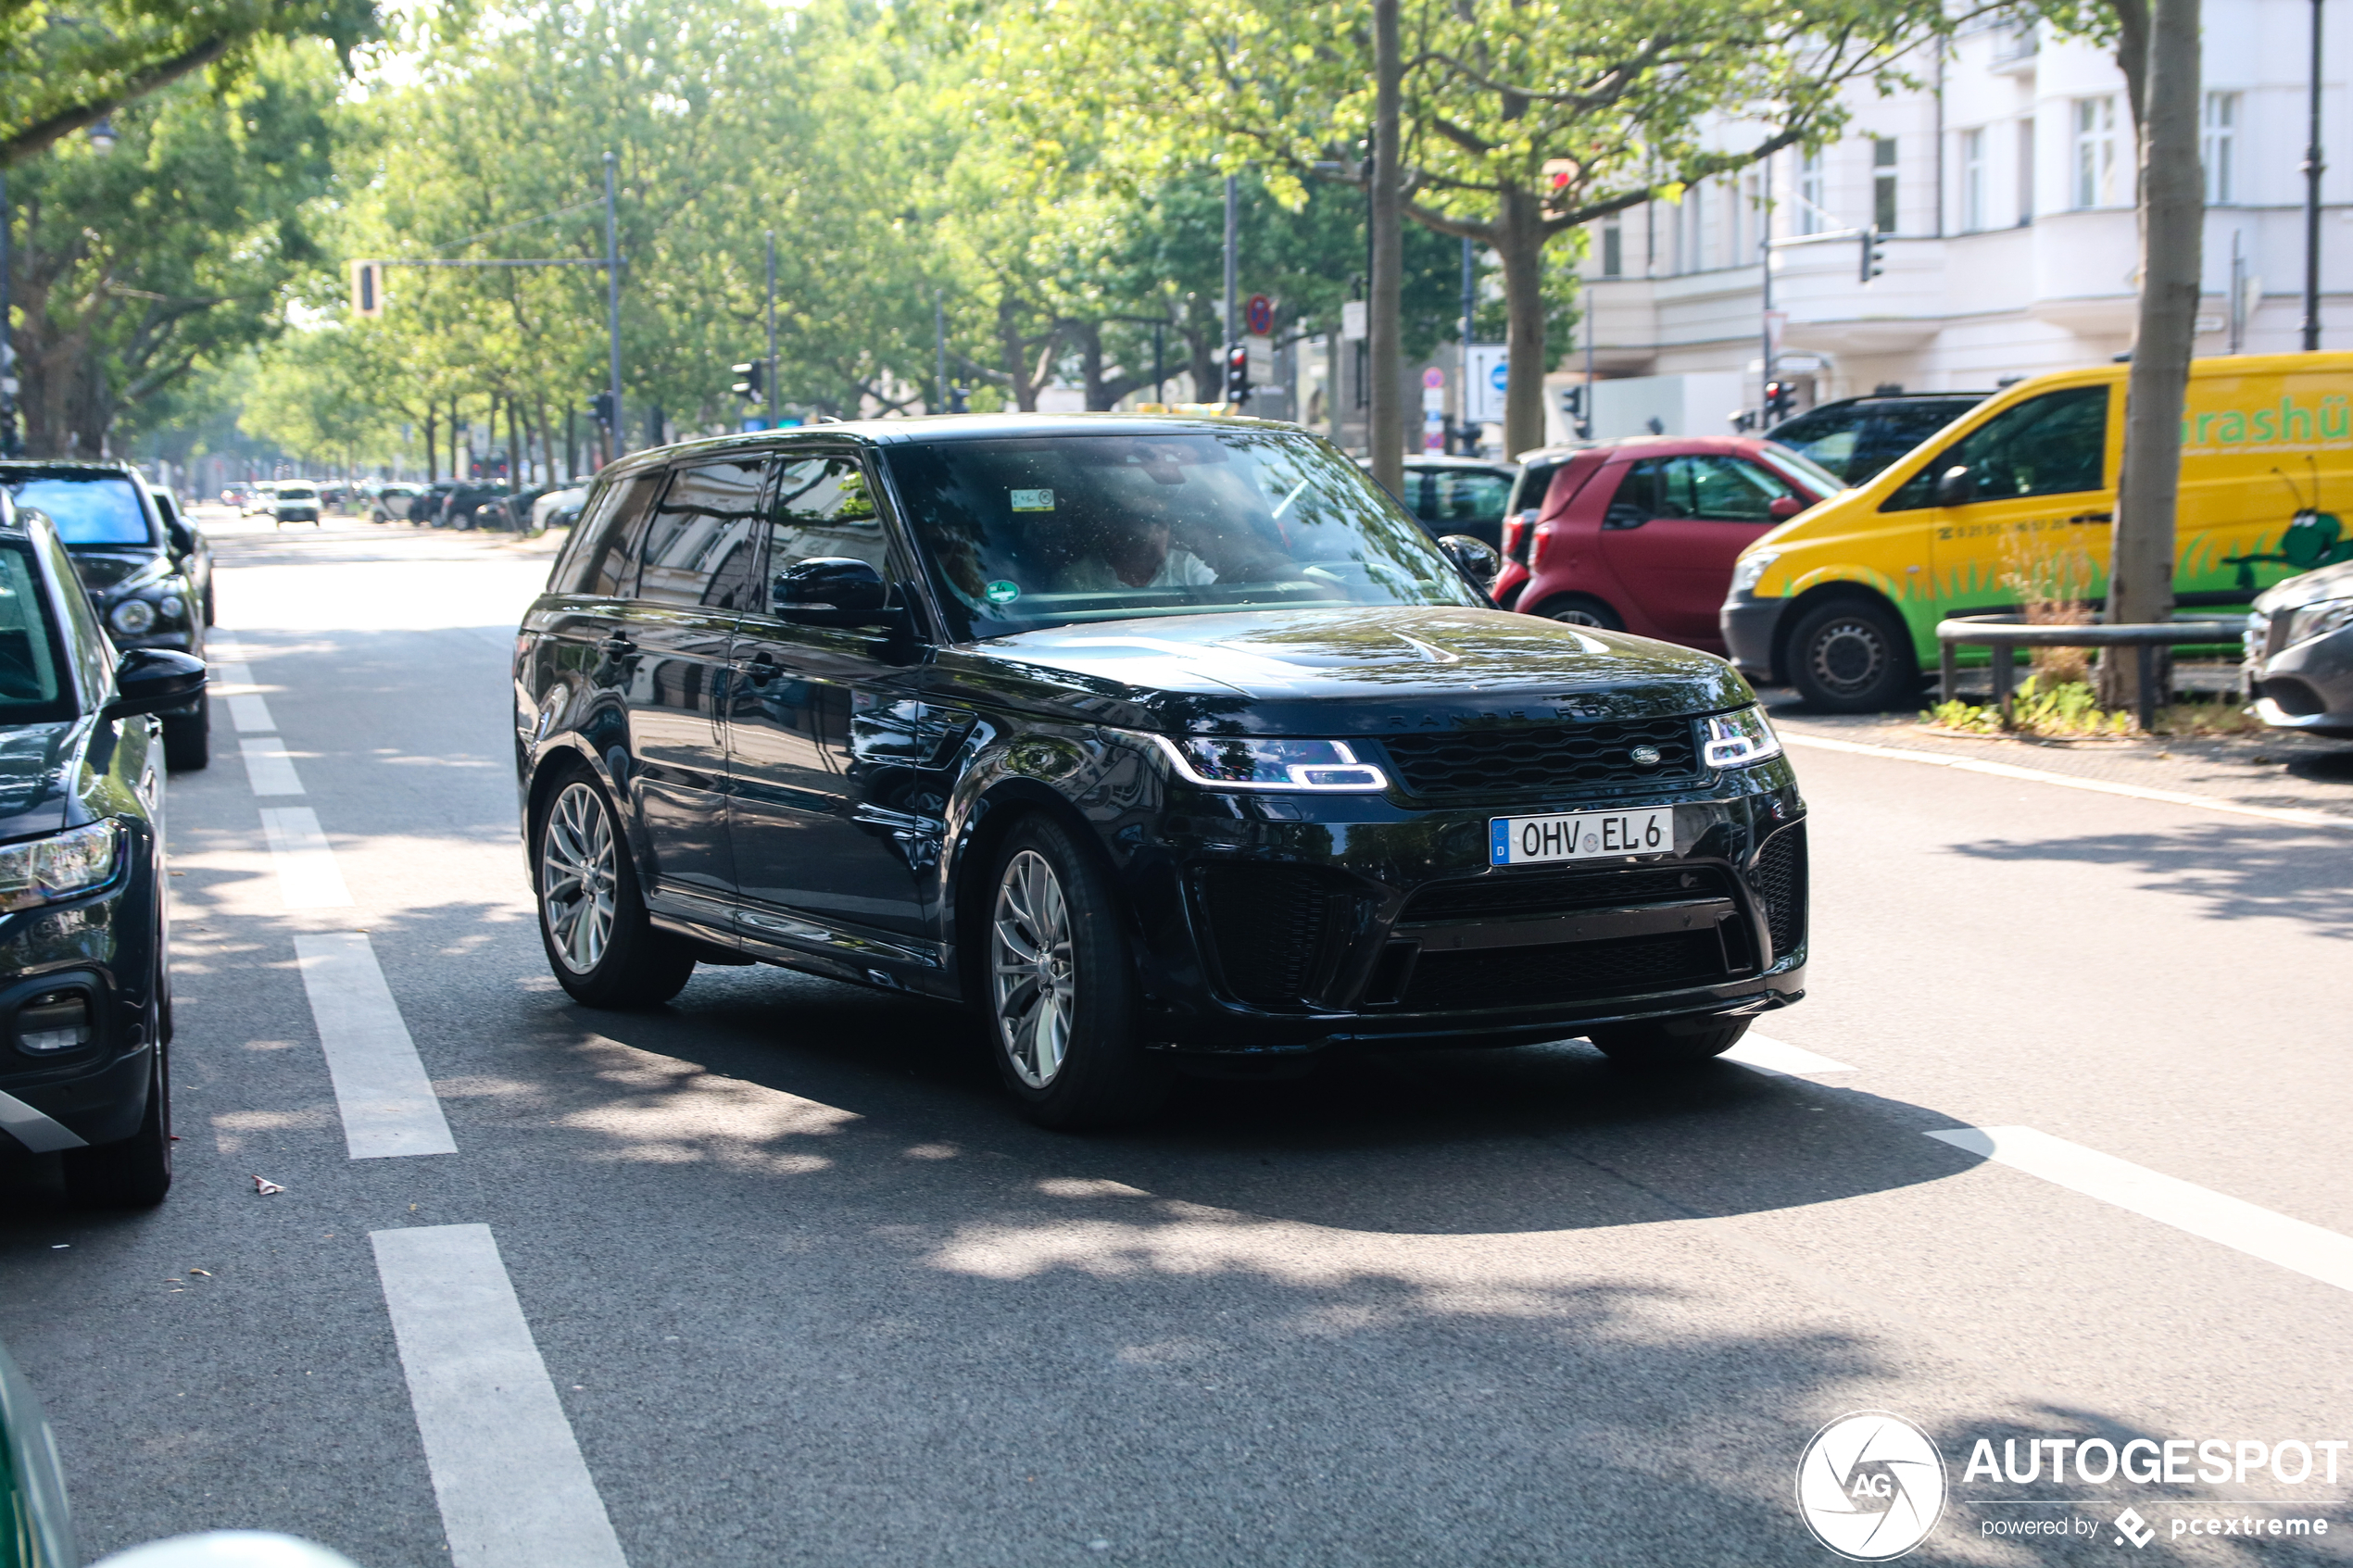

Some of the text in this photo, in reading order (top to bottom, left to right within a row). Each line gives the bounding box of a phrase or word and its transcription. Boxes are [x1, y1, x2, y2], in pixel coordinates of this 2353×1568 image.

[2181, 395, 2350, 444] rashü
[1387, 698, 1675, 728] RANGE ROVER
[1496, 846, 1504, 857] D
[1523, 815, 1661, 856] OHV EL 6
